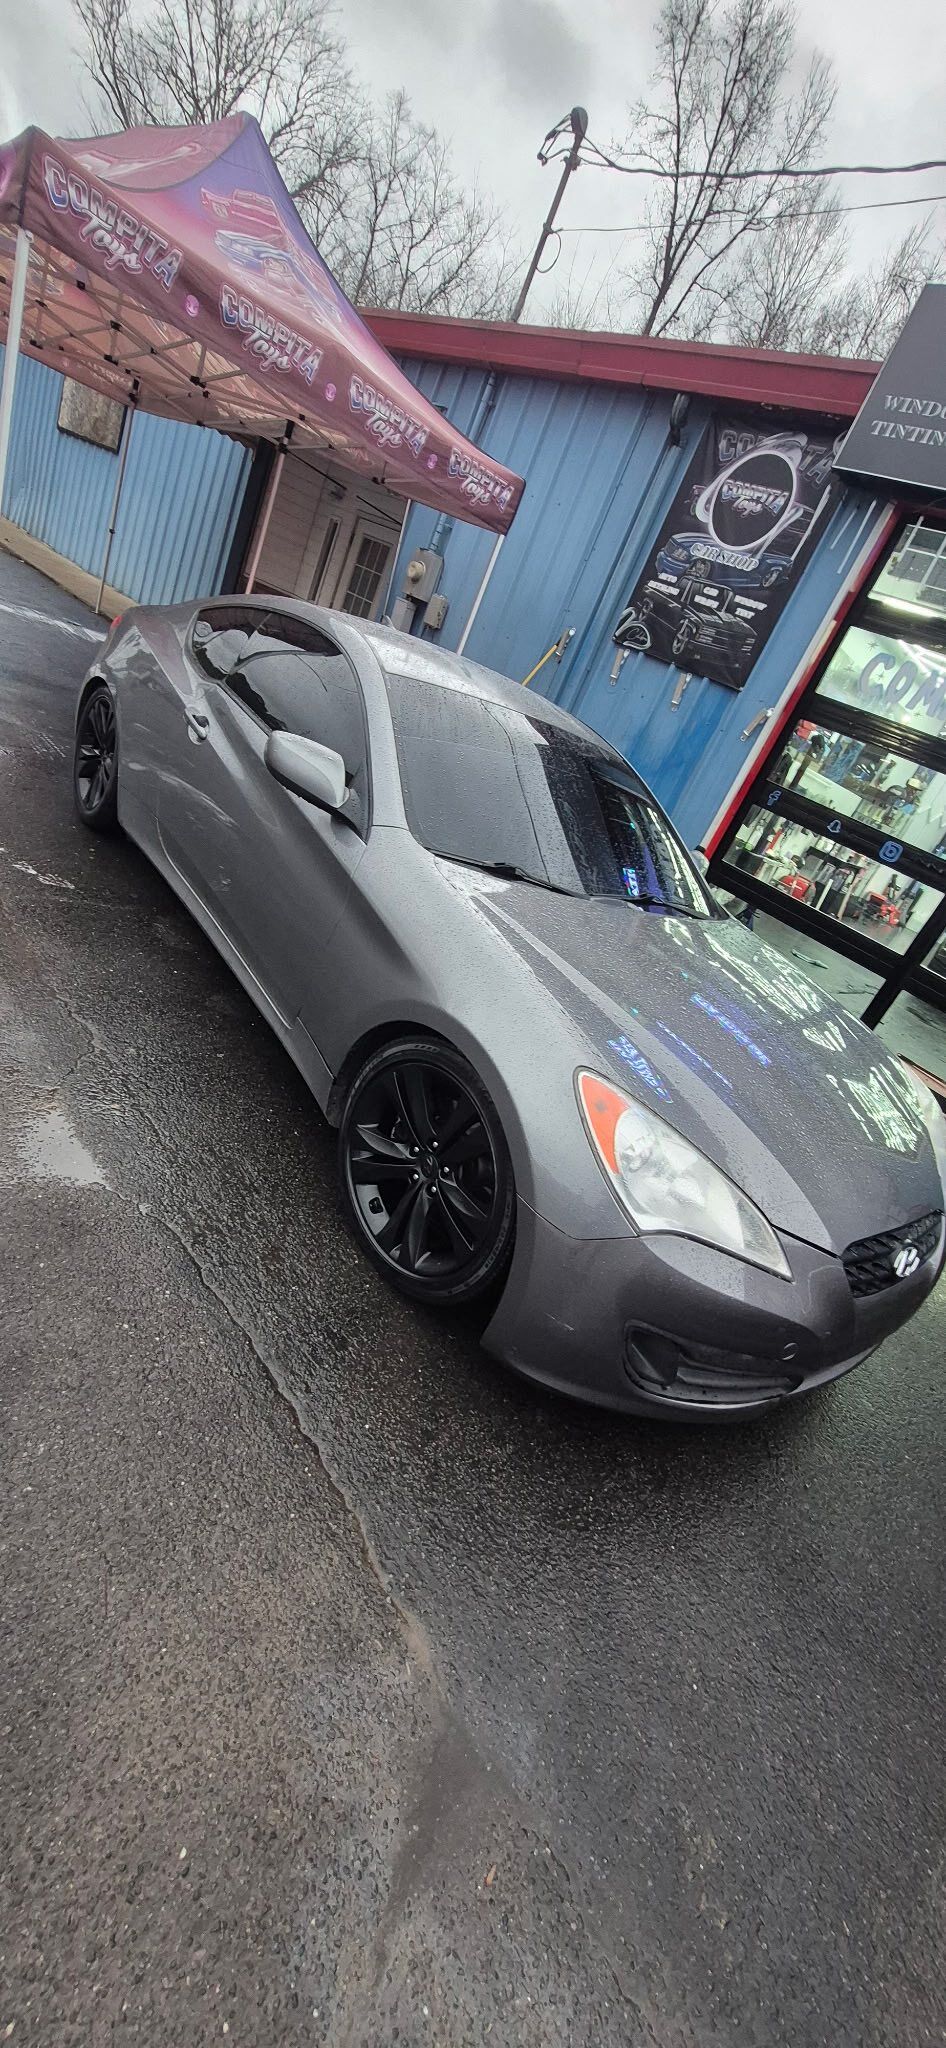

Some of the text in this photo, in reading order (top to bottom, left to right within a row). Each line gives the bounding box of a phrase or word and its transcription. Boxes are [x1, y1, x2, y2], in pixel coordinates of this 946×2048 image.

[43, 154, 184, 293] COMPITA
[80, 207, 143, 274] Toys
[219, 284, 323, 385] COMPITA
[242, 325, 291, 372] Toys
[349, 374, 430, 459] COMPITA
[365, 408, 402, 448] Toys
[884, 394, 946, 419] WIND
[448, 448, 514, 513] COMPITA
[460, 473, 491, 506] Toys
[721, 479, 789, 517] COMPITA
